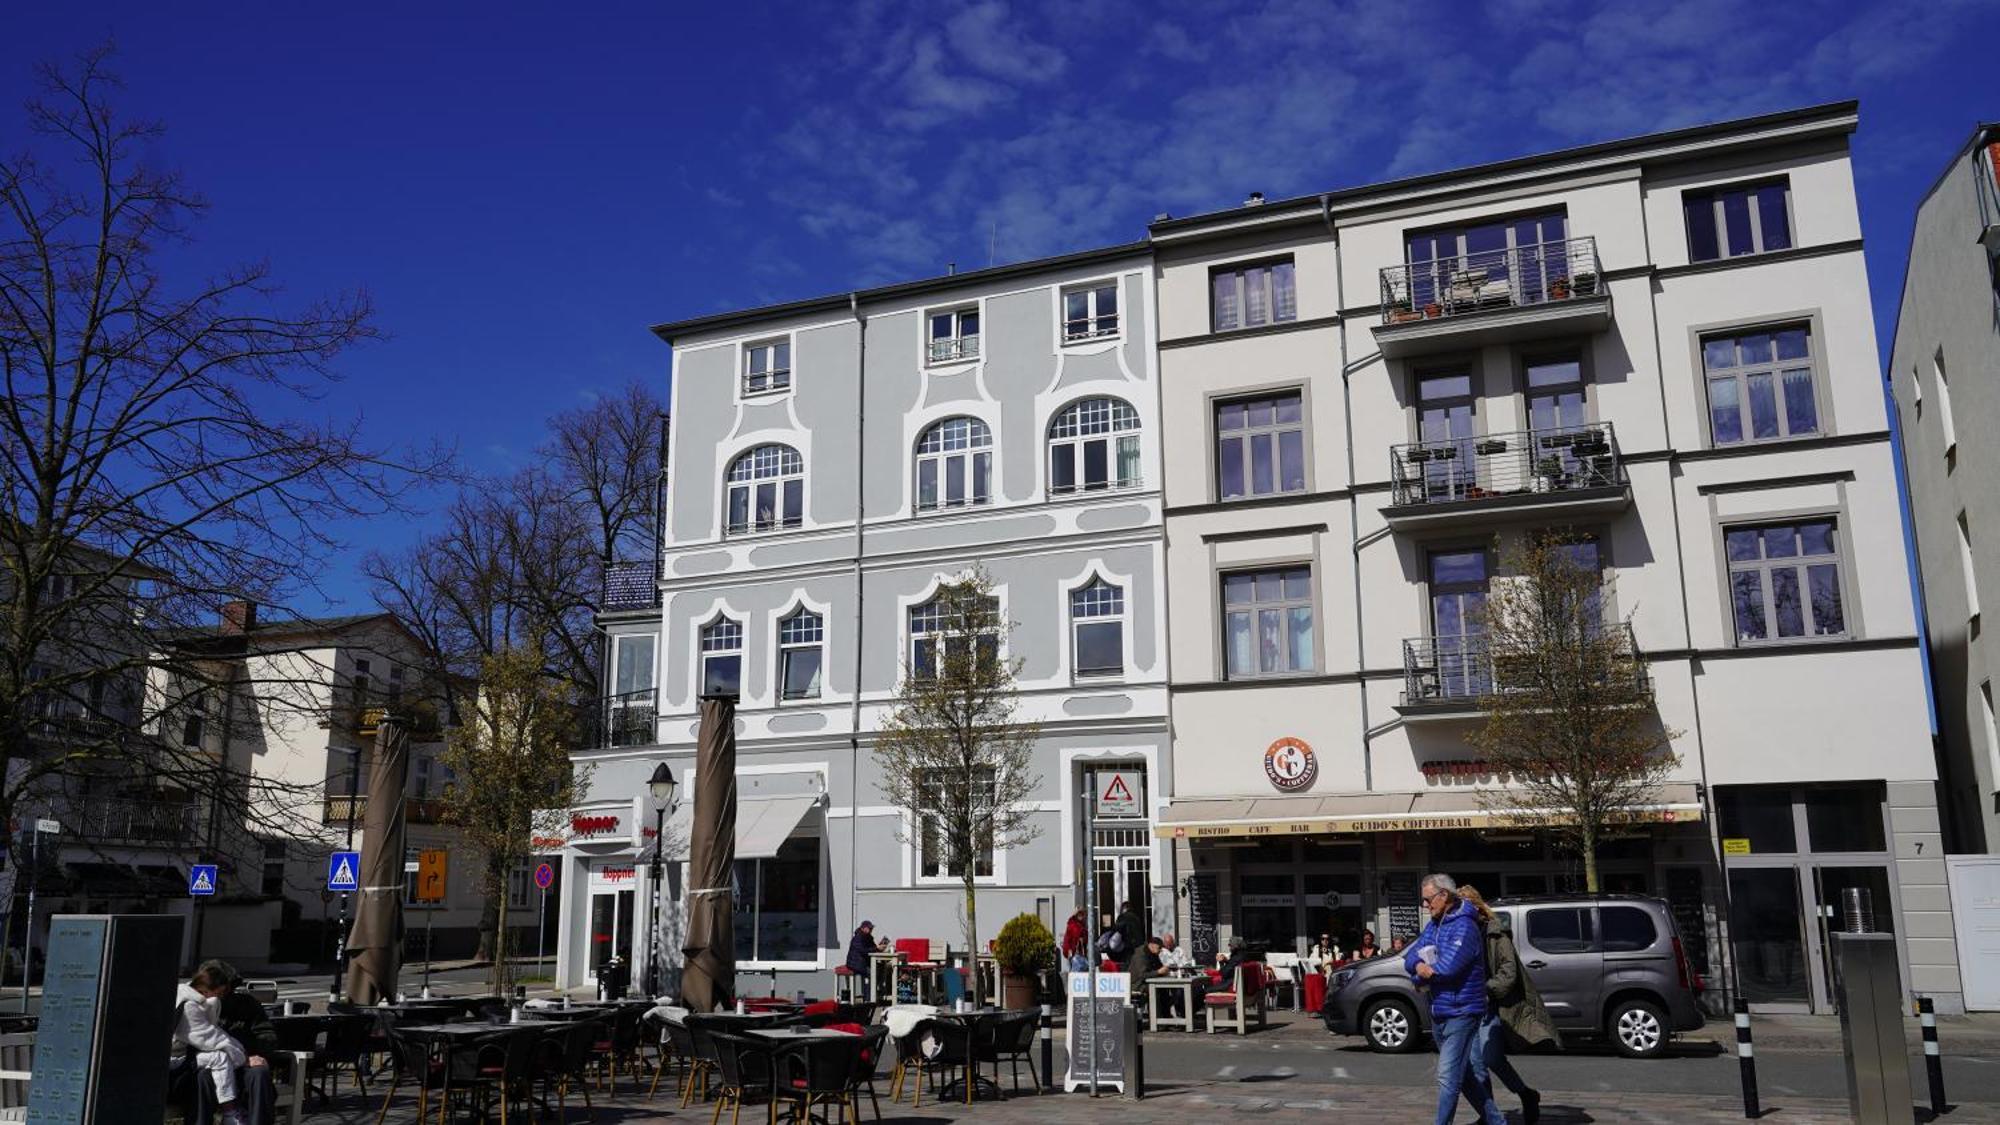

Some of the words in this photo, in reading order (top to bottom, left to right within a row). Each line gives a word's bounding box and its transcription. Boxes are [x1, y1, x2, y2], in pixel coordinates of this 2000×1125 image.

[1198, 827, 1230, 835] BISTRO
[1290, 824, 1309, 832] BAR
[1352, 820, 1399, 831] GUIDO'S
[1402, 818, 1472, 829] COFFEEBAR
[1915, 842, 1924, 855] 7
[1073, 978, 1093, 993] GI
[1100, 978, 1125, 992] SUL
